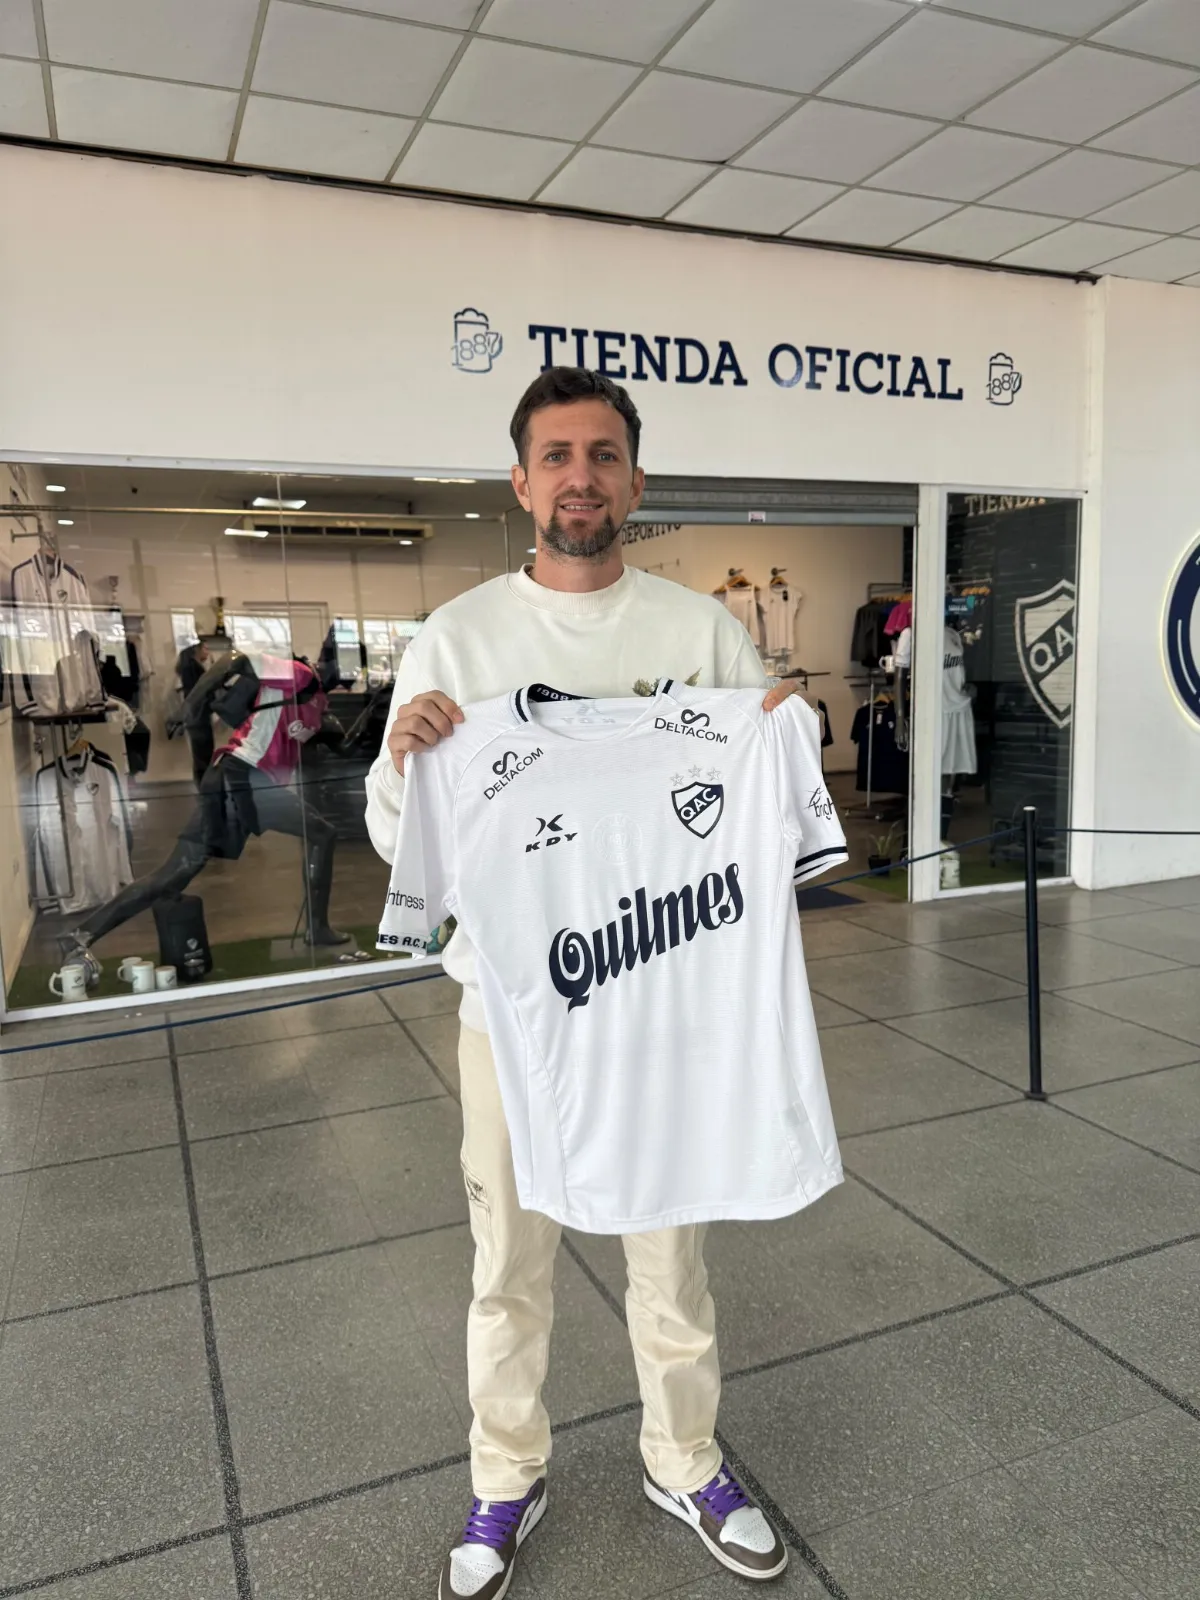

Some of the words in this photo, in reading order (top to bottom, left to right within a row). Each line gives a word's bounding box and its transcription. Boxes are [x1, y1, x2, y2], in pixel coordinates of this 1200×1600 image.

[450, 331, 500, 367] 1887
[528, 324, 748, 387] TIENDA
[768, 343, 963, 401] OFICIAL
[985, 371, 1021, 401] 1887
[1029, 613, 1076, 673] QA
[654, 717, 728, 744] DELTACOM
[483, 747, 544, 800] DELTACOM
[680, 787, 717, 820] QAC
[525, 832, 578, 853] KDY
[376, 933, 399, 945] ES
[549, 863, 744, 1015] Quilmes
